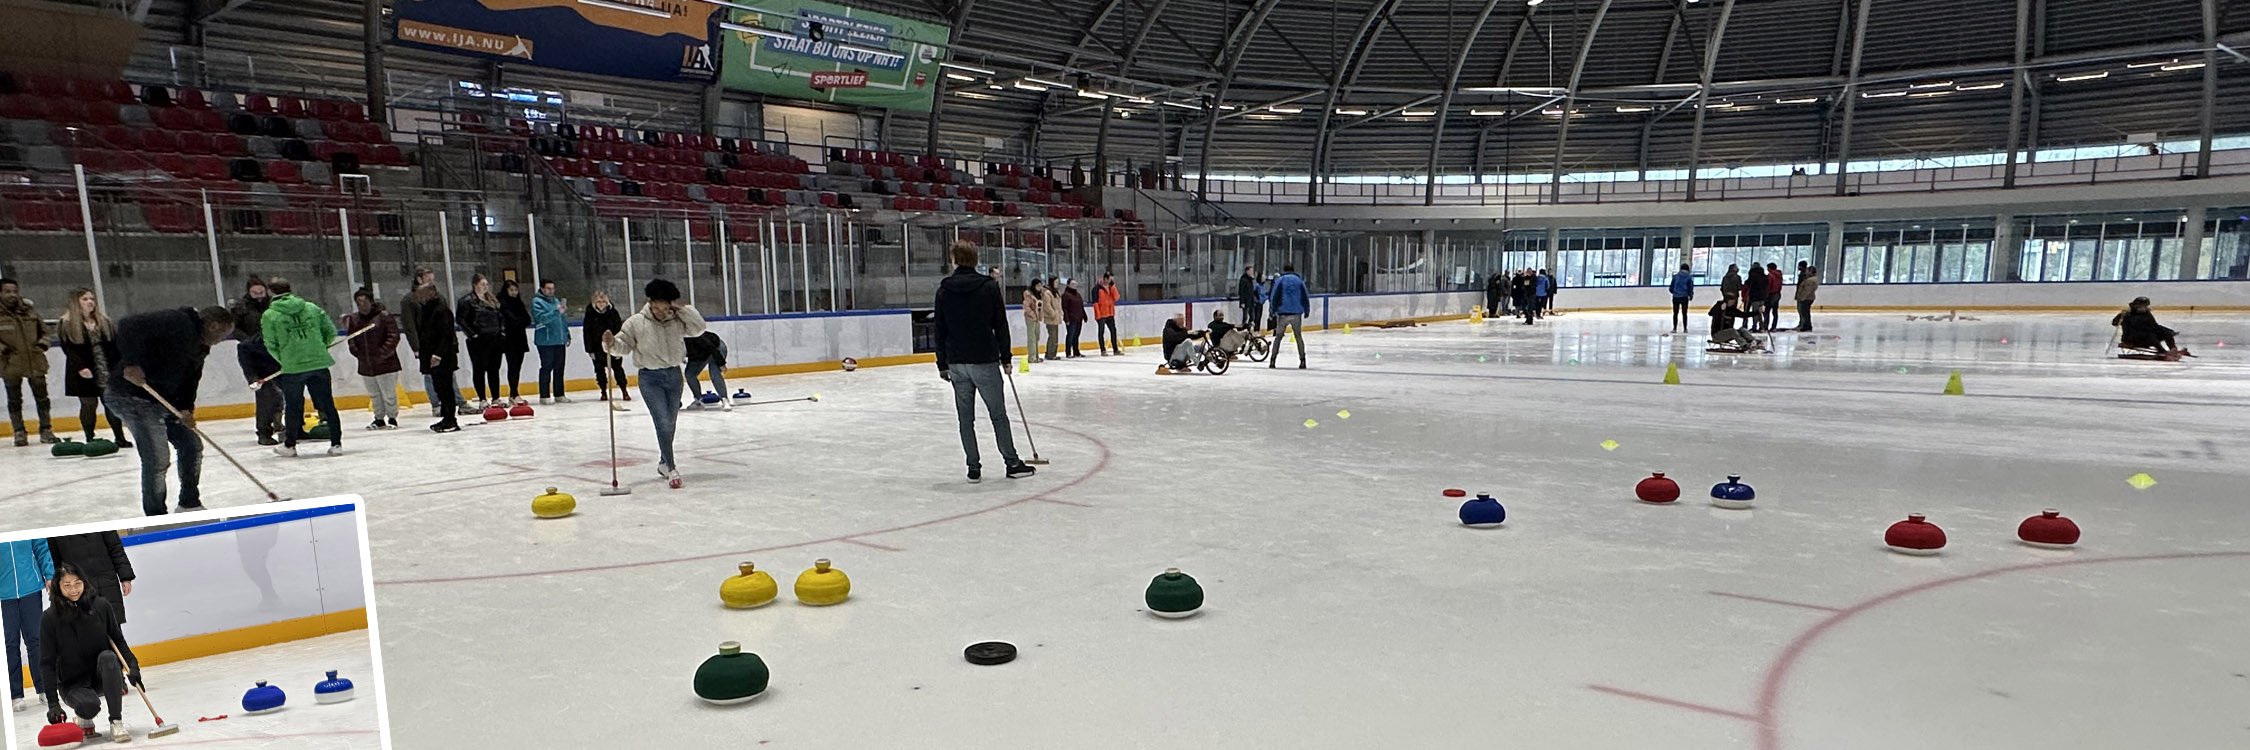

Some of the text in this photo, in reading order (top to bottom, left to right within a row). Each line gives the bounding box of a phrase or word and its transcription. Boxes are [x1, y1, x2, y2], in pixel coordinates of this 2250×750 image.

[773, 37, 812, 54] STAAT
[812, 41, 833, 57] BIJ
[831, 45, 855, 61] ONS
[857, 50, 873, 64] OP
[813, 74, 866, 86] SPORTLIEF
